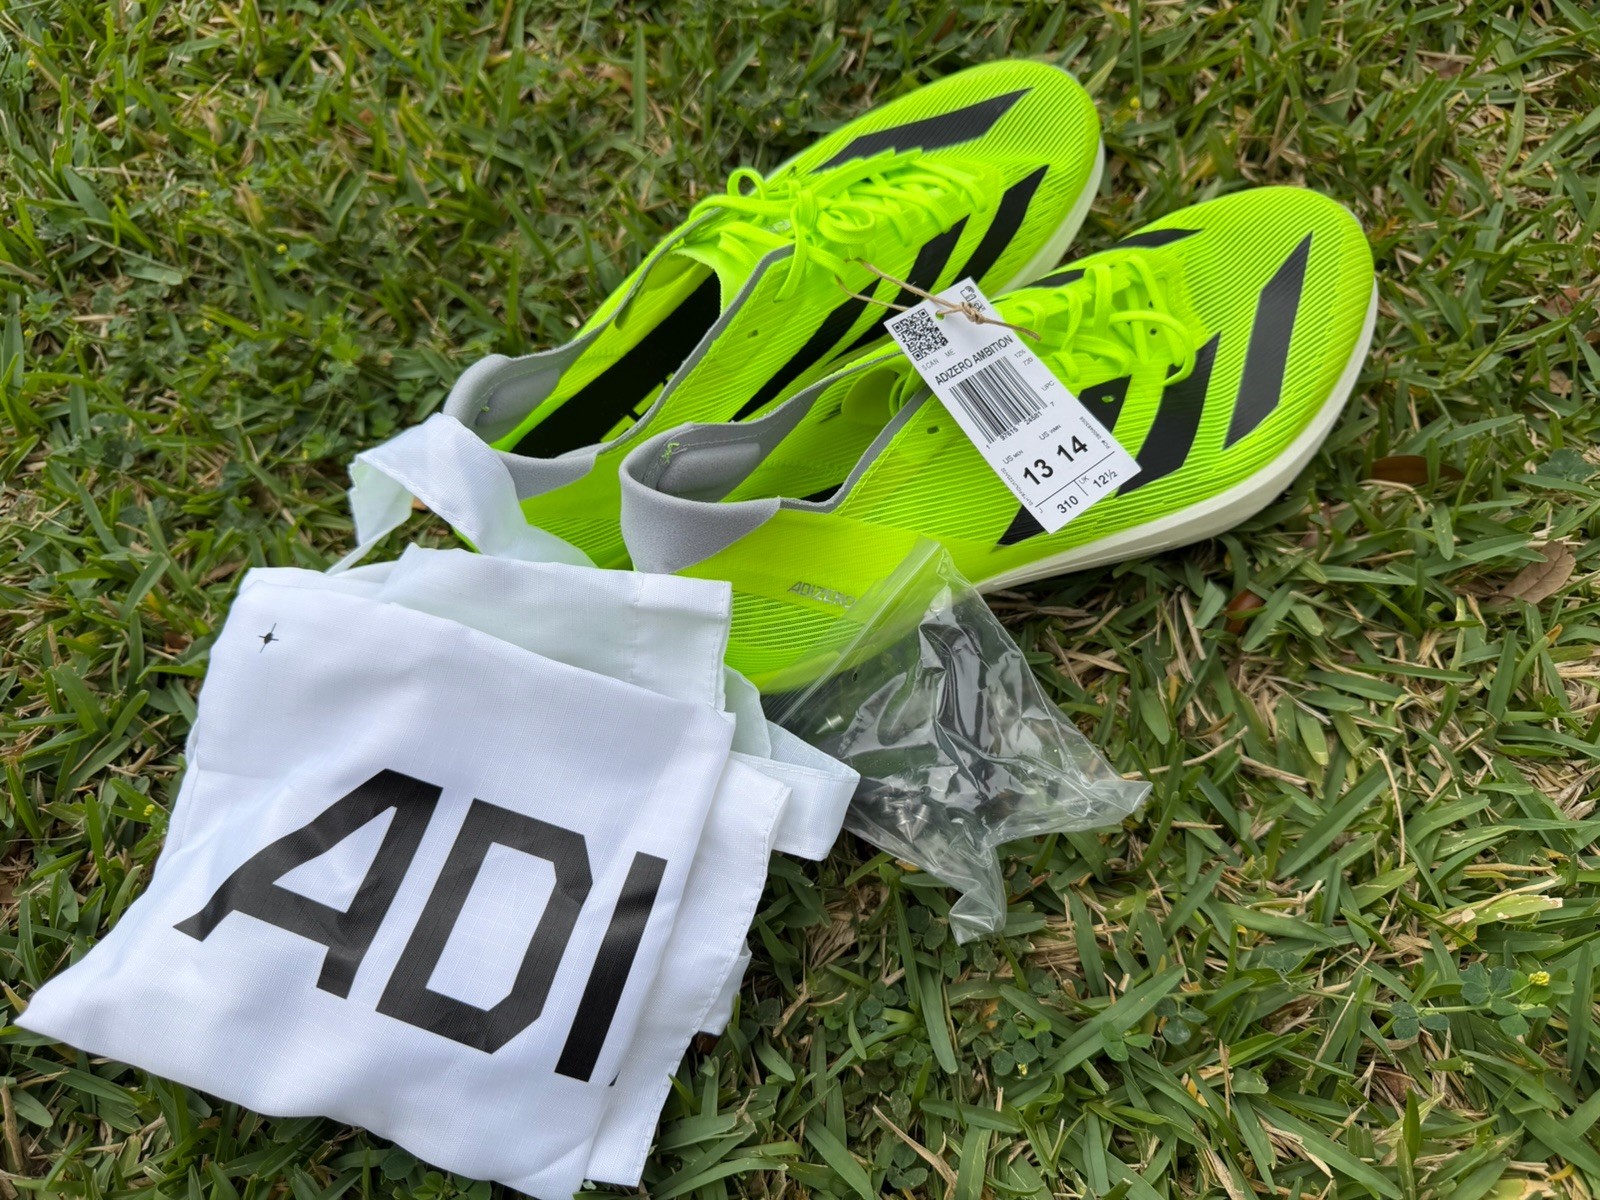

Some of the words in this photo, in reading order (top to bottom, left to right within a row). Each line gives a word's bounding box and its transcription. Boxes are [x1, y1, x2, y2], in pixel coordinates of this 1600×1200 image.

[922, 357, 939, 371] SCAN
[944, 348, 955, 358] ME
[934, 358, 974, 386] ADIZERO
[971, 334, 1013, 363] AMBITION
[1038, 431, 1049, 440] US
[1002, 455, 1013, 464] US
[1056, 434, 1088, 463] 14
[1023, 458, 1054, 486] 13
[1078, 475, 1089, 484] UK
[1057, 495, 1079, 514] 310
[787, 581, 856, 609] ADIZERO
[173, 768, 668, 1083] ADI
